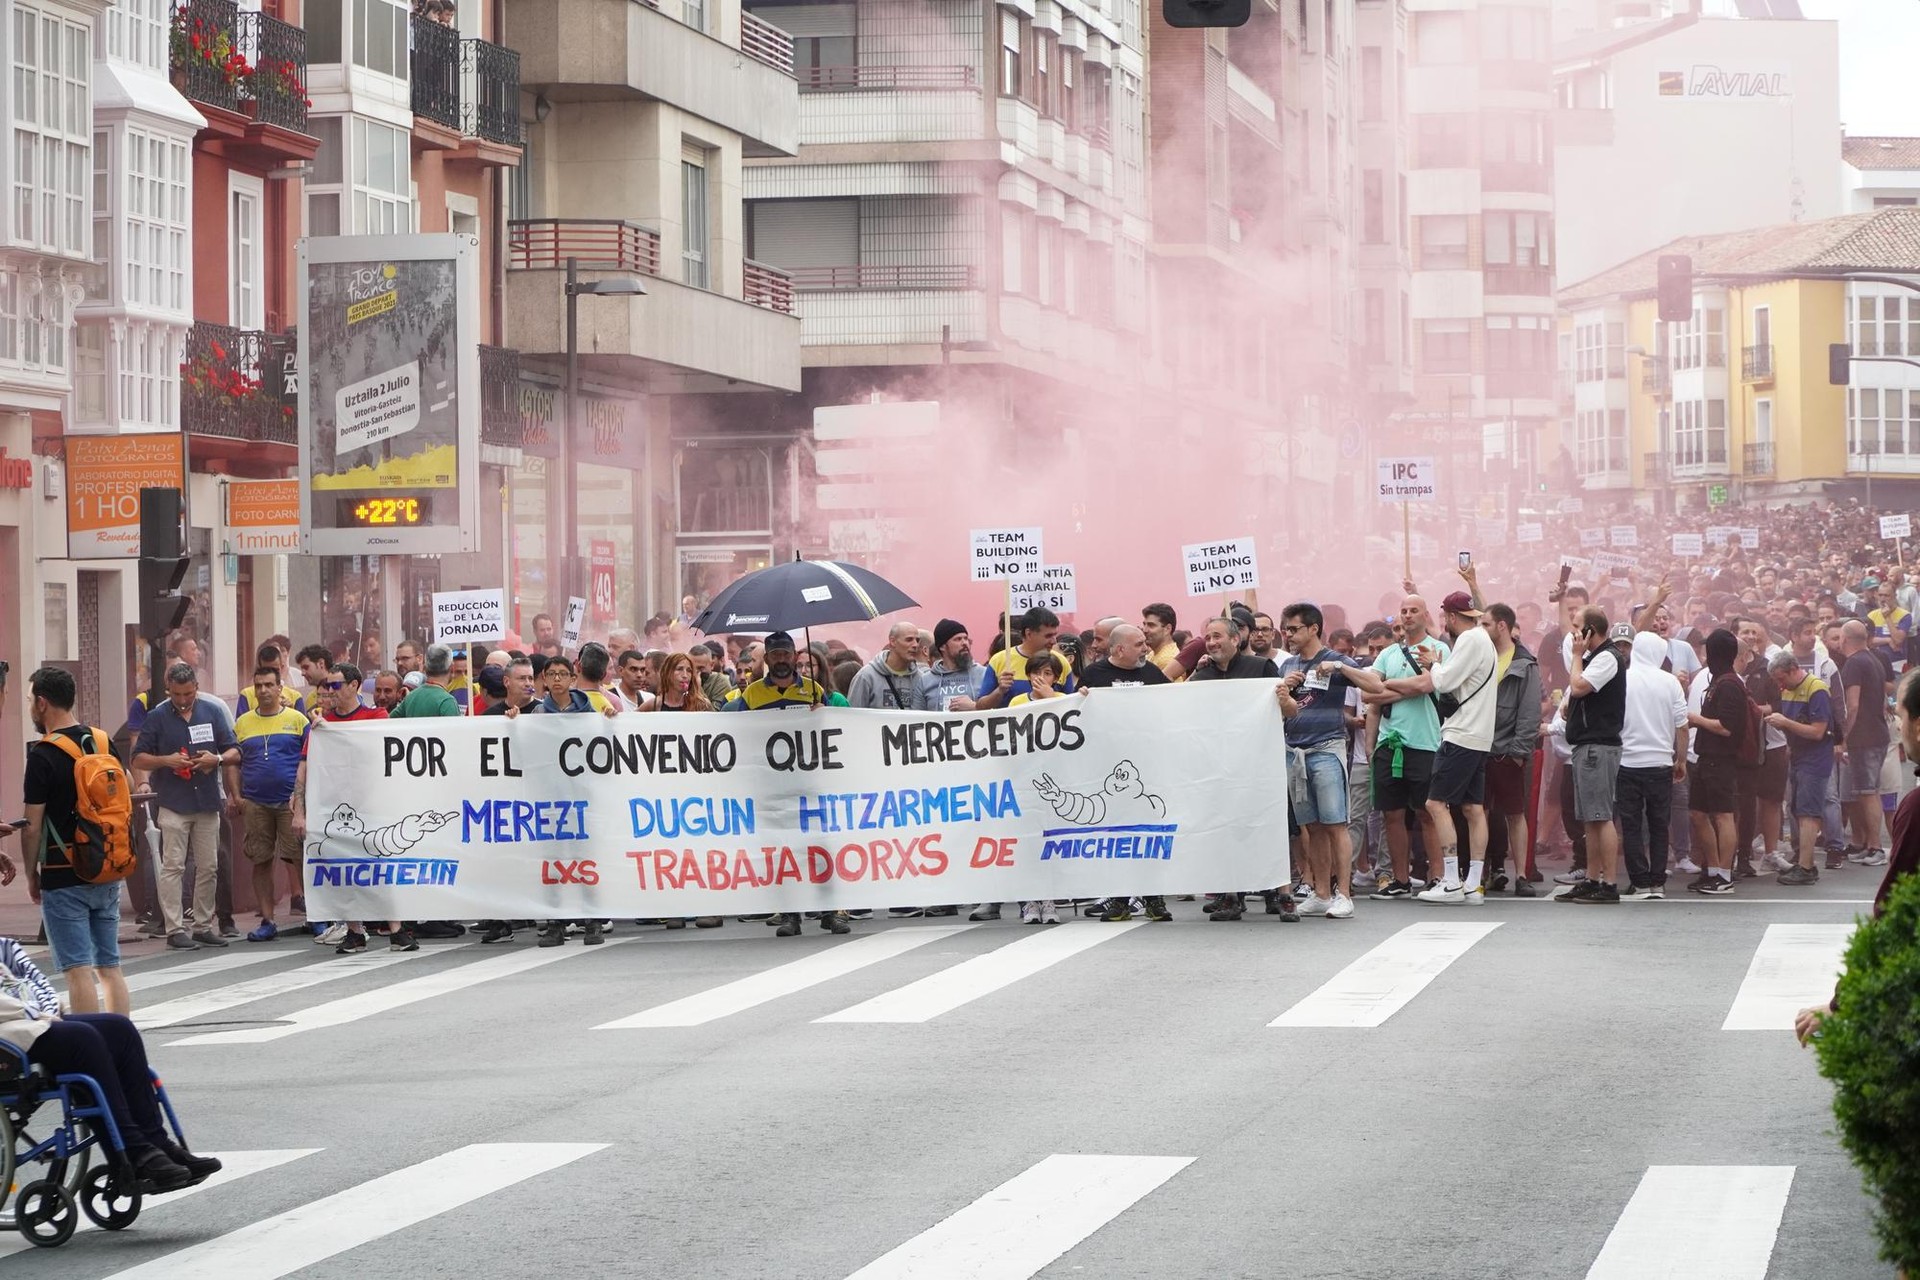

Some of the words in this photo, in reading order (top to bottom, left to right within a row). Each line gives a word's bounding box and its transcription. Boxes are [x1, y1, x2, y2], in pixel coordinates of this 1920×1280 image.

[344, 387, 379, 408] Uztaila
[380, 383, 386, 396] 2
[387, 376, 410, 393] Julio
[354, 395, 402, 419] Vitoria-Gasteiz
[518, 388, 555, 422] ACTORY
[340, 415, 383, 437] Donostia-San
[366, 428, 377, 439] 210
[377, 426, 389, 435] km
[76, 441, 117, 455] Patxi
[121, 440, 175, 455] Aznar
[74, 470, 141, 481] LABORATORIO
[143, 469, 178, 479] DIGITAL
[1392, 462, 1418, 480] IPC
[1380, 484, 1394, 495] Sin
[1396, 485, 1433, 498] trampas
[75, 497, 85, 519] 1
[98, 495, 140, 519] HO
[235, 510, 265, 520] FOTO
[267, 509, 300, 520] CARN
[96, 532, 141, 543] Revelad
[236, 530, 300, 549] 1minut
[989, 533, 1024, 543] TEAM
[976, 546, 1038, 557] BUILDING
[1200, 543, 1237, 558] TEAM
[994, 562, 1020, 574] NO
[1025, 562, 1038, 573] !!!
[1190, 555, 1251, 573] BUILDING
[1043, 567, 1073, 578] NTÍA
[1209, 574, 1235, 588] NO
[1240, 571, 1253, 583] !!!
[1011, 582, 1071, 593] SALARIAL
[438, 599, 499, 612] REDUCCIÓN
[1020, 595, 1033, 608] SÍ
[1037, 600, 1046, 608] o
[1050, 593, 1064, 607] SÍ
[454, 613, 467, 622] DE
[471, 612, 484, 621] LA
[440, 623, 499, 638] JORNADA
[384, 736, 447, 777] POR
[481, 736, 523, 777] EL
[558, 732, 737, 777] CONVENIO
[765, 728, 845, 772] QUE
[881, 709, 1085, 767] MERECEMOS
[461, 799, 590, 844] MEREZI
[628, 796, 755, 839] DUGUN
[799, 778, 1022, 834] HITZARMENA
[1040, 835, 1175, 861] MICHELIN
[541, 859, 599, 885] LXS
[625, 832, 949, 892] TRABAJADORXS
[970, 836, 1018, 868] DE
[312, 860, 460, 888] MICHELIN
